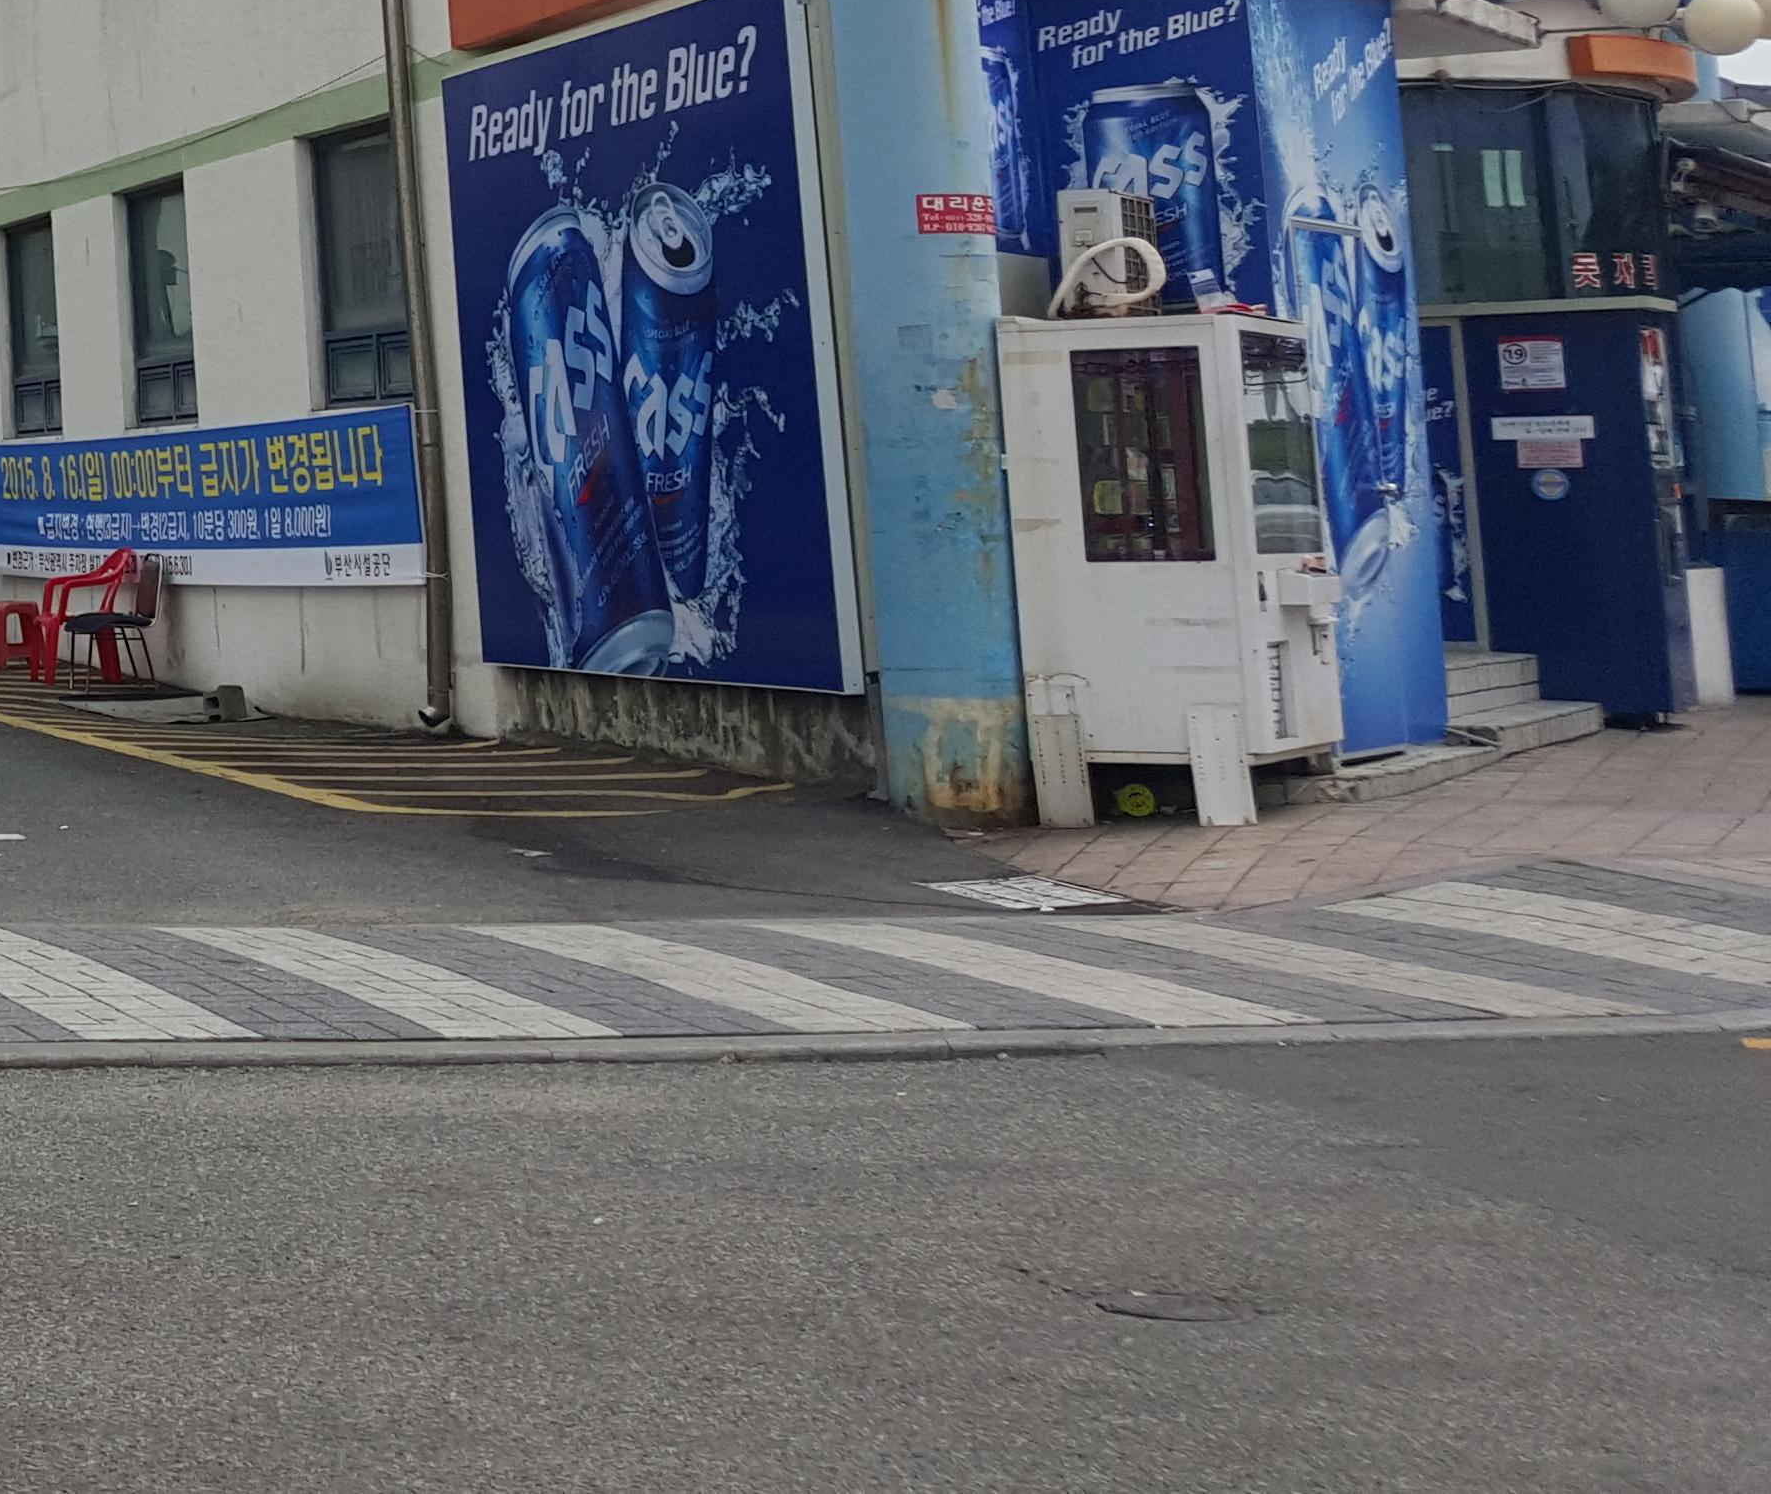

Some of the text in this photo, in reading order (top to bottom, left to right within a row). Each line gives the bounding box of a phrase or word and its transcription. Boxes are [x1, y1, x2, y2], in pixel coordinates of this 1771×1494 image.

[1037, 7, 1123, 53] Ready
[1070, 39, 1114, 71] for
[1117, 23, 1161, 54] the
[1312, 36, 1349, 101] Ready
[1329, 16, 1393, 126] for the Blue?
[467, 24, 758, 162] Ready for the Blue?
[1505, 346, 1525, 361] 19
[0, 455, 39, 503] 2015.
[41, 453, 58, 501] 8.
[111, 447, 194, 501] 00:00부터
[198, 440, 261, 498] 급지가
[265, 424, 384, 496] 변경됩니다
[568, 412, 611, 504] FRESH
[644, 467, 692, 494] FRESH
[44, 512, 80, 542] 급지변경
[192, 510, 226, 541] 10분당
[263, 507, 282, 539] 1일
[67, 553, 88, 573] 주차장
[333, 552, 393, 579] 부산시설공단
